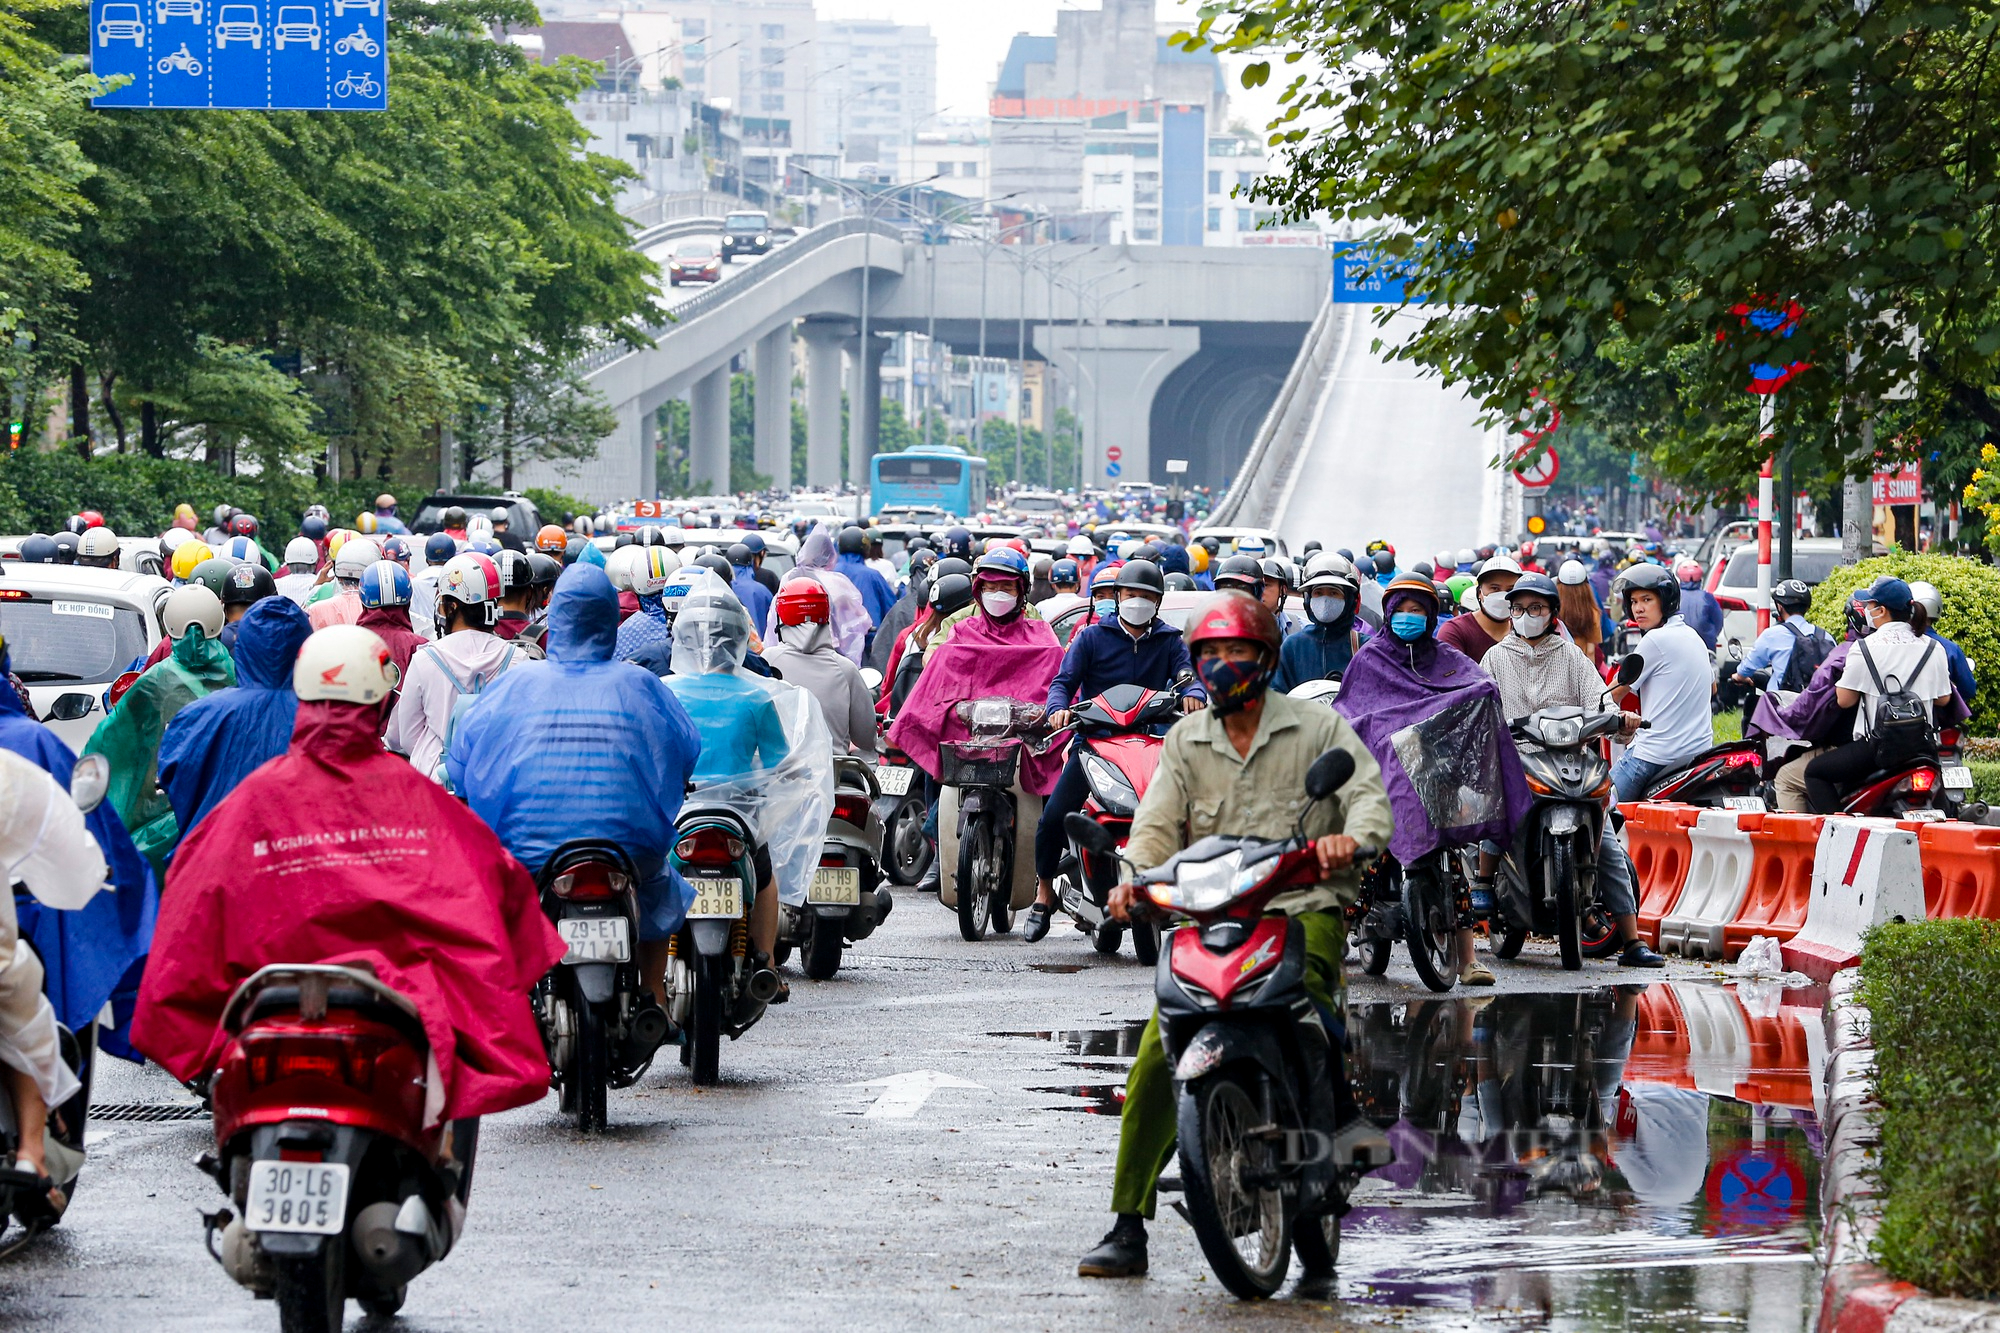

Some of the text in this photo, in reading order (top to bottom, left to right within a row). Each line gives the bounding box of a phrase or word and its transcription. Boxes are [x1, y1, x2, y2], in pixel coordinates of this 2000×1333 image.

[1368, 279, 1382, 291] TÔ
[1872, 477, 1886, 502] VỆ
[1888, 479, 1917, 498] SINH
[57, 603, 110, 616] XE HỢP ĐỒNG
[880, 768, 907, 781] 29-E2
[1946, 778, 1971, 787] 19.99
[1729, 799, 1760, 811] 29-H2
[814, 869, 852, 885] 30-H9
[814, 886, 852, 902] 8973
[569, 920, 617, 939] 29-E1
[265, 1168, 333, 1197] 30-L6
[261, 1198, 329, 1227] 3805
